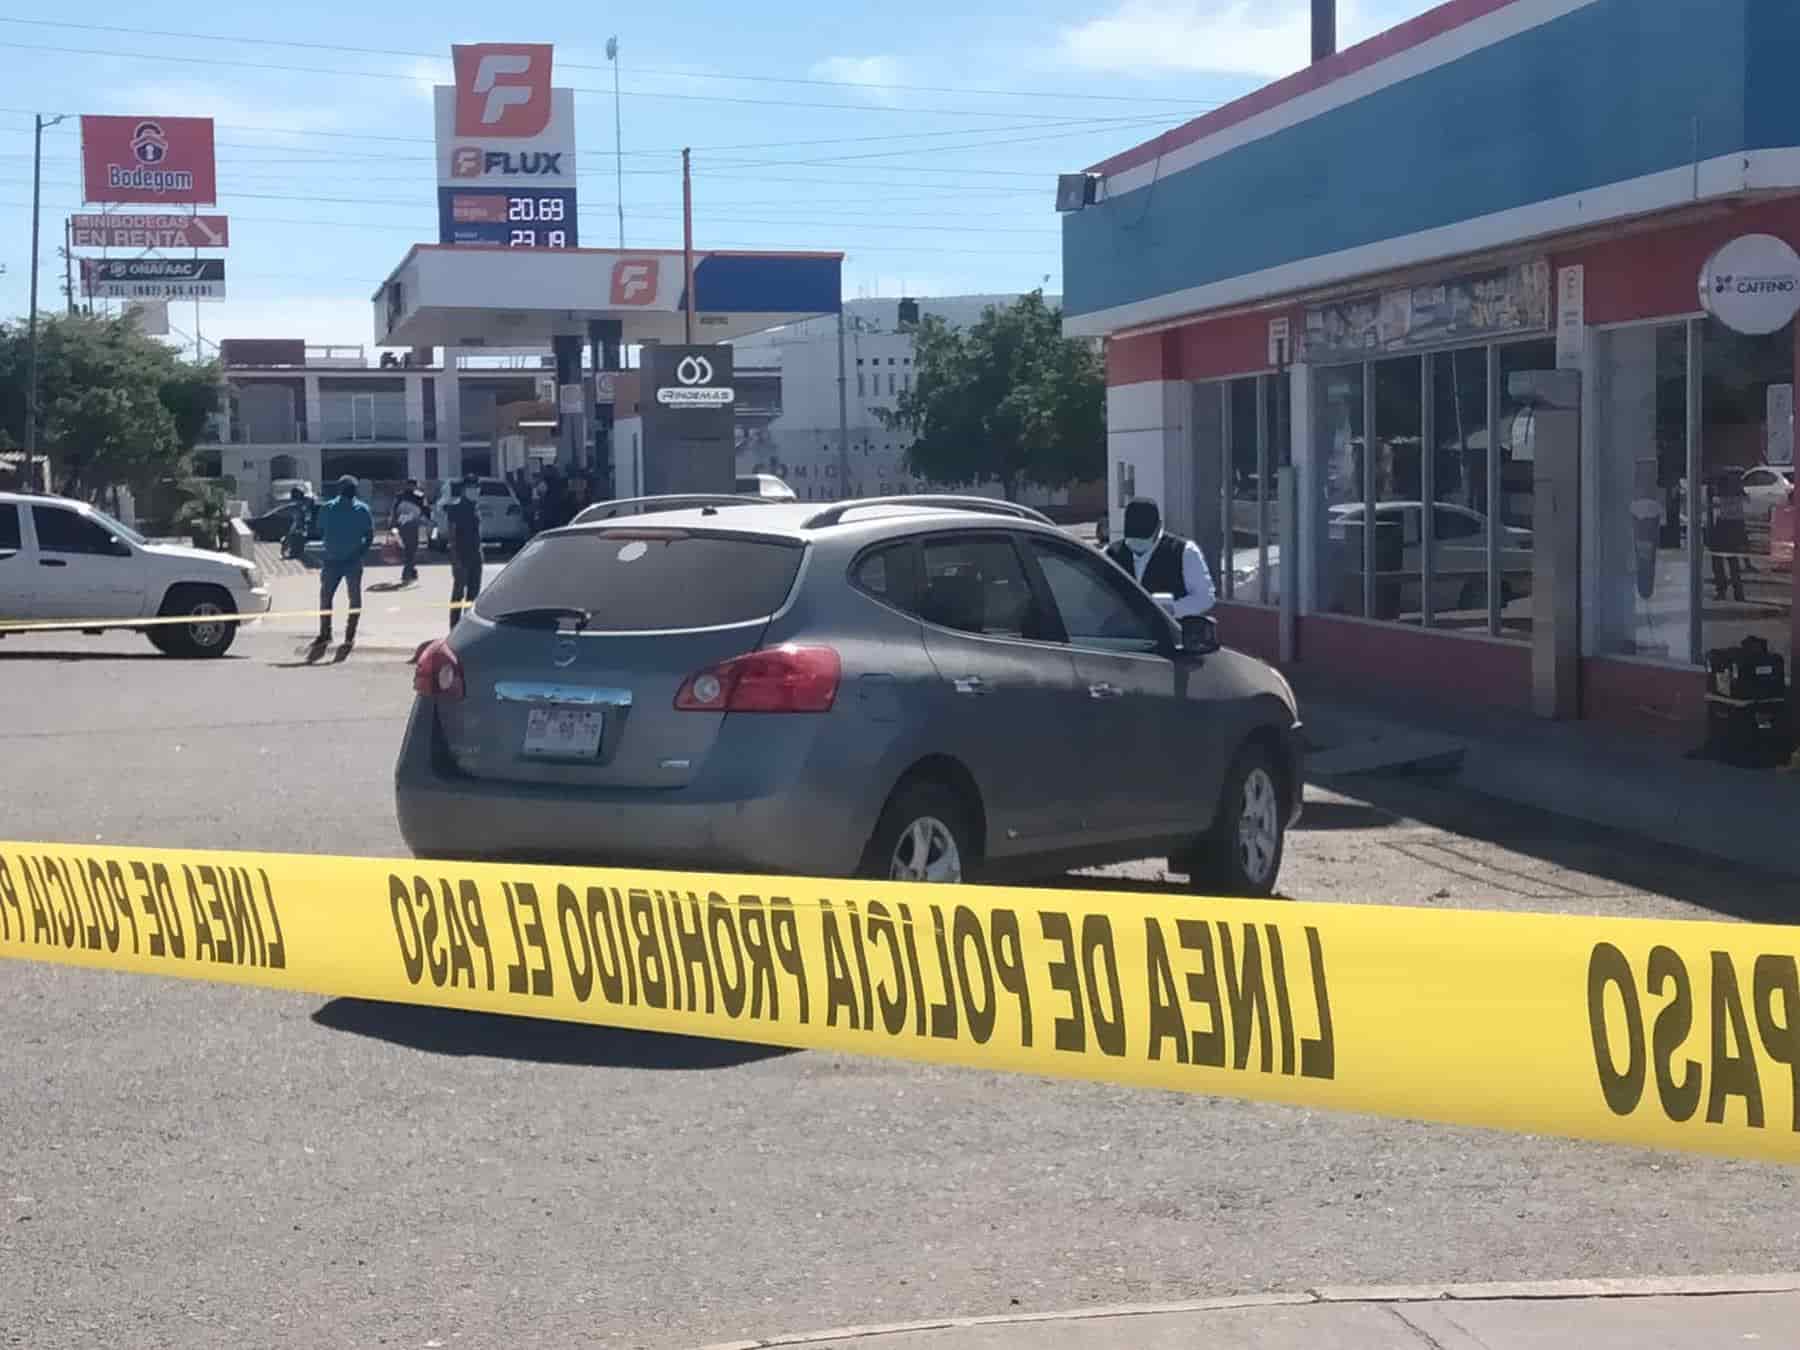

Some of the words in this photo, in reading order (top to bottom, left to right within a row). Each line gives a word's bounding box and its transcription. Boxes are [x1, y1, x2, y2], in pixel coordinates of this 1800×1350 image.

[484, 152, 562, 175] FLUX
[107, 163, 193, 193] Bodegom
[509, 198, 564, 221] 20.69
[76, 230, 107, 246] EN
[114, 231, 191, 246] RENTA
[1737, 280, 1794, 294] CAFFENIO
